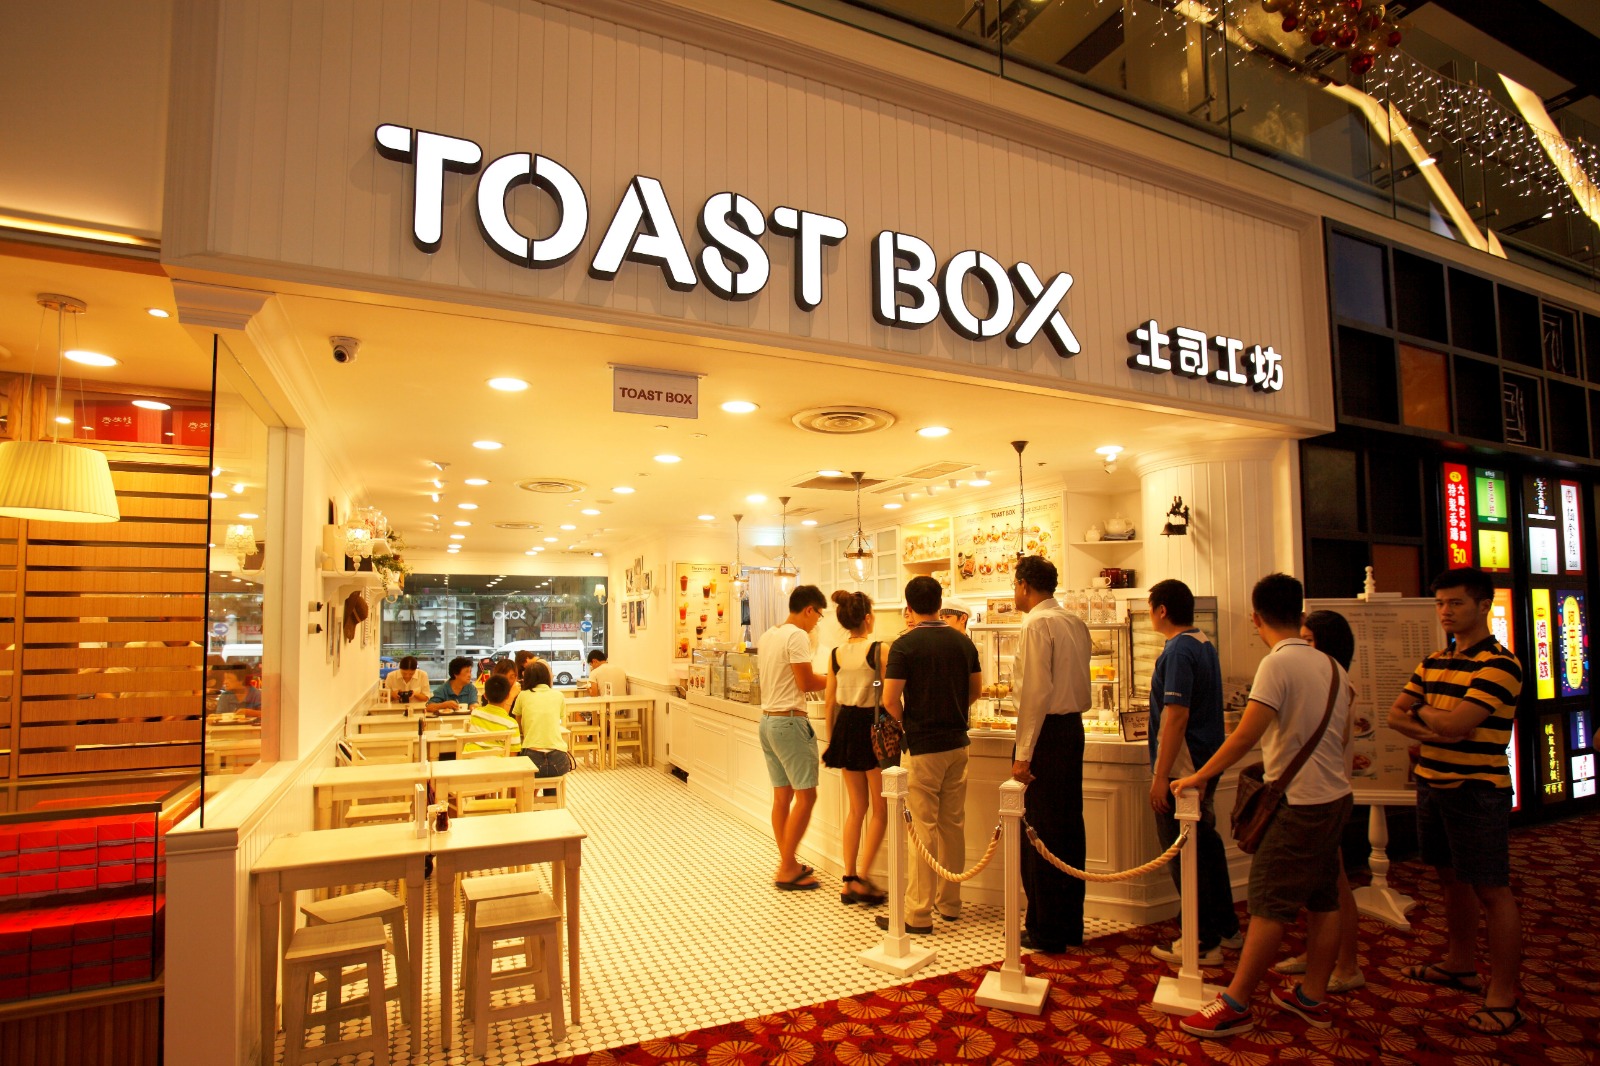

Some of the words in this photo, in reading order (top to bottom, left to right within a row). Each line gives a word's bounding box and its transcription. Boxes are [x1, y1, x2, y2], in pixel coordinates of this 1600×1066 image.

[374, 123, 849, 309] TOAST
[872, 230, 1082, 356] BOX
[1128, 319, 1284, 393] 土司工坊
[619, 386, 664, 401] TOAST
[666, 392, 693, 405] BOX
[990, 510, 1005, 518] TOAST
[1006, 508, 1016, 516] BOX
[1453, 548, 1467, 564] 50
